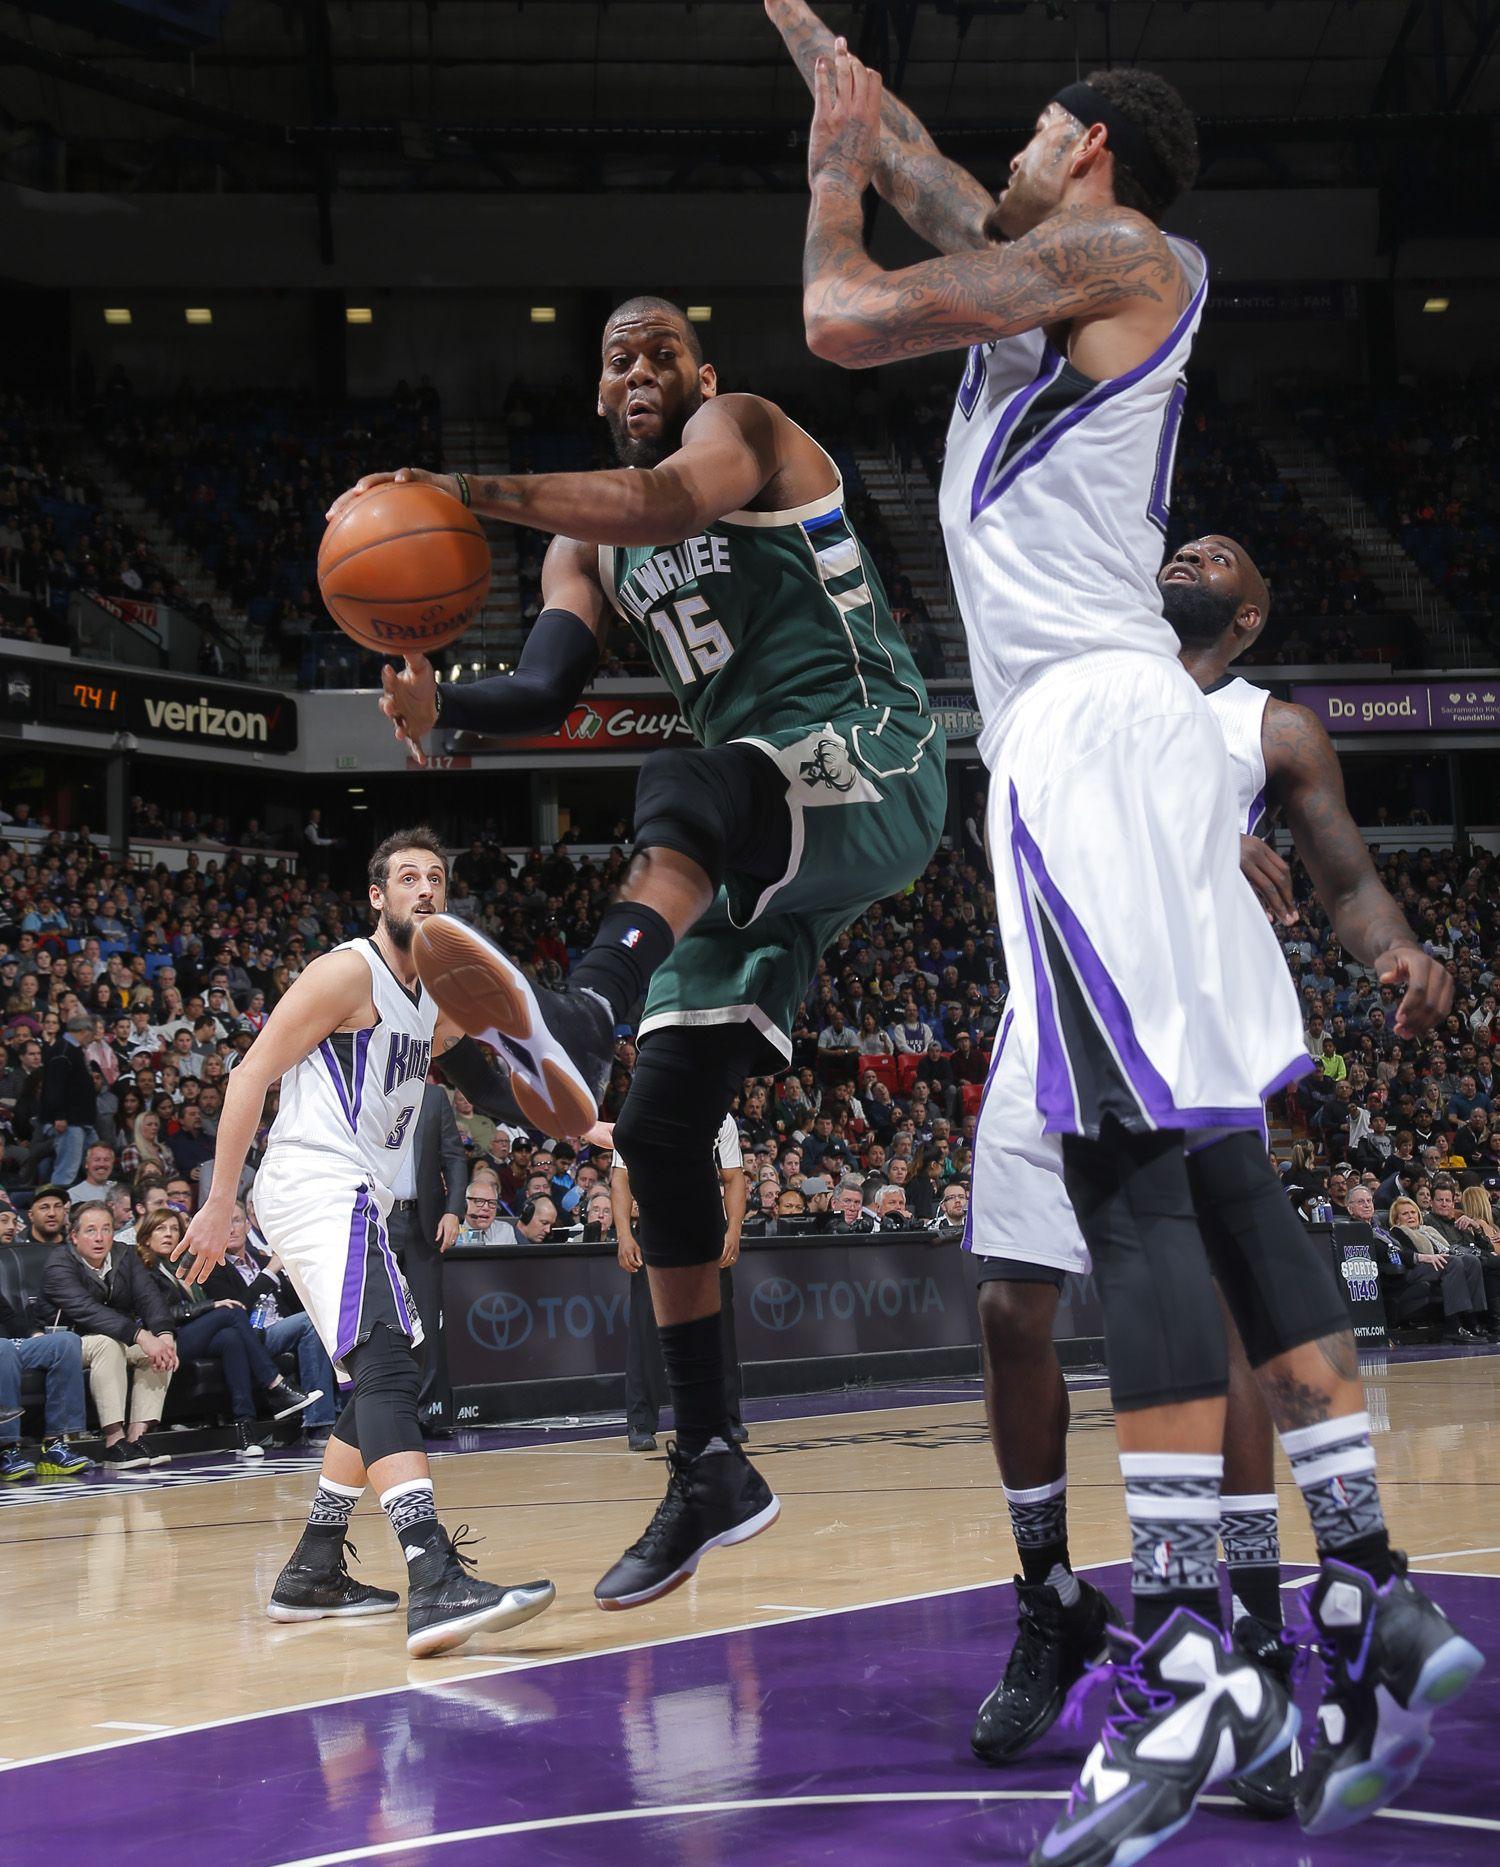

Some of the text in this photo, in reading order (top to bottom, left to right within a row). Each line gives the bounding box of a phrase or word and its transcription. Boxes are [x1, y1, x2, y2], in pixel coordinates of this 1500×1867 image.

[649, 595, 735, 685] 15
[144, 697, 268, 741] verizon
[1328, 696, 1417, 721] Do good.
[384, 1032, 433, 1096] KING
[385, 1106, 415, 1149] 3
[1341, 1260, 1379, 1278] SPORTS
[1343, 1245, 1371, 1260] KHTK
[807, 1277, 945, 1320] TOYOTA
[1347, 1280, 1379, 1301] 1140
[537, 1294, 630, 1339] TOY
[1353, 1326, 1385, 1337] KHTK.COM
[457, 1405, 480, 1419] ANC
